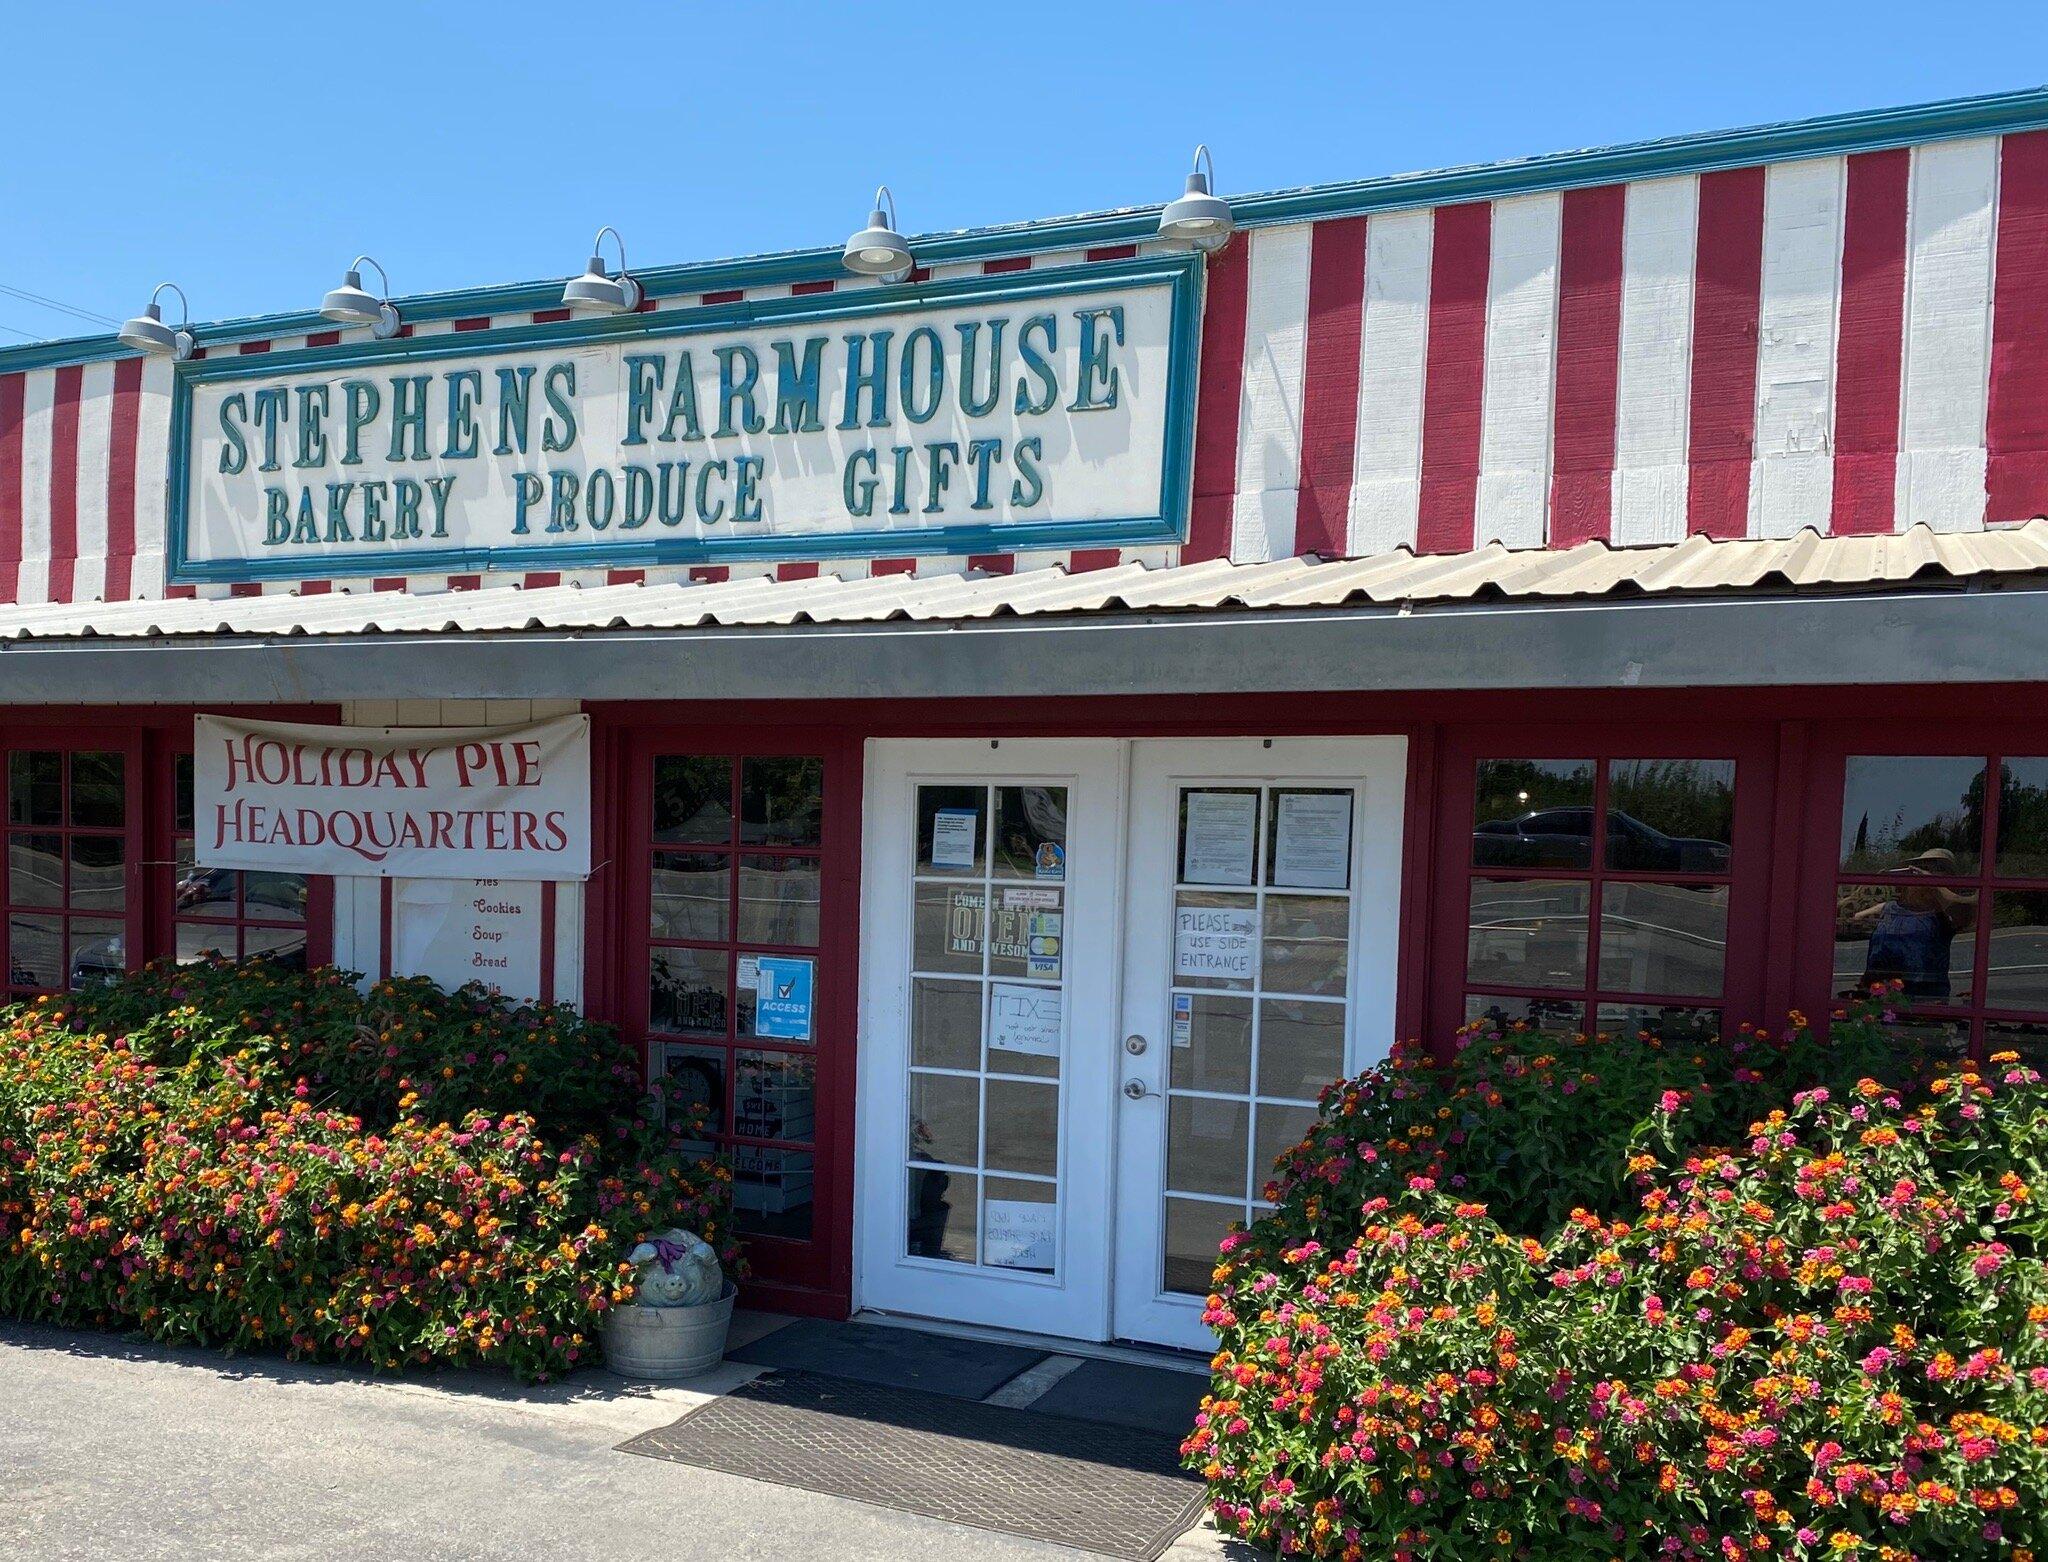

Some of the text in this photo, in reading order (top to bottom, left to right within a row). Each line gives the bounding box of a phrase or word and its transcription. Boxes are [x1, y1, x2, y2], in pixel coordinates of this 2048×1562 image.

[219, 306, 1124, 475] STEPHENS FARMHOUSE
[262, 437, 1043, 546] BAKERY PRODUCE GIFTS
[224, 734, 542, 792] HOLIDAY PIE
[213, 798, 567, 861] HEADQUARTERS
[472, 898, 521, 914] Cookies
[954, 894, 985, 908] COME
[1180, 913, 1230, 932] PLEASE
[472, 925, 502, 943] Soup
[952, 938, 1028, 957] AND AWESOM
[1190, 936, 1247, 951] USE SIDE
[472, 951, 507, 968] Bread
[1034, 963, 1054, 972] VISA
[1181, 952, 1249, 972] ENTRANCE
[762, 1001, 807, 1014] ACCESS
